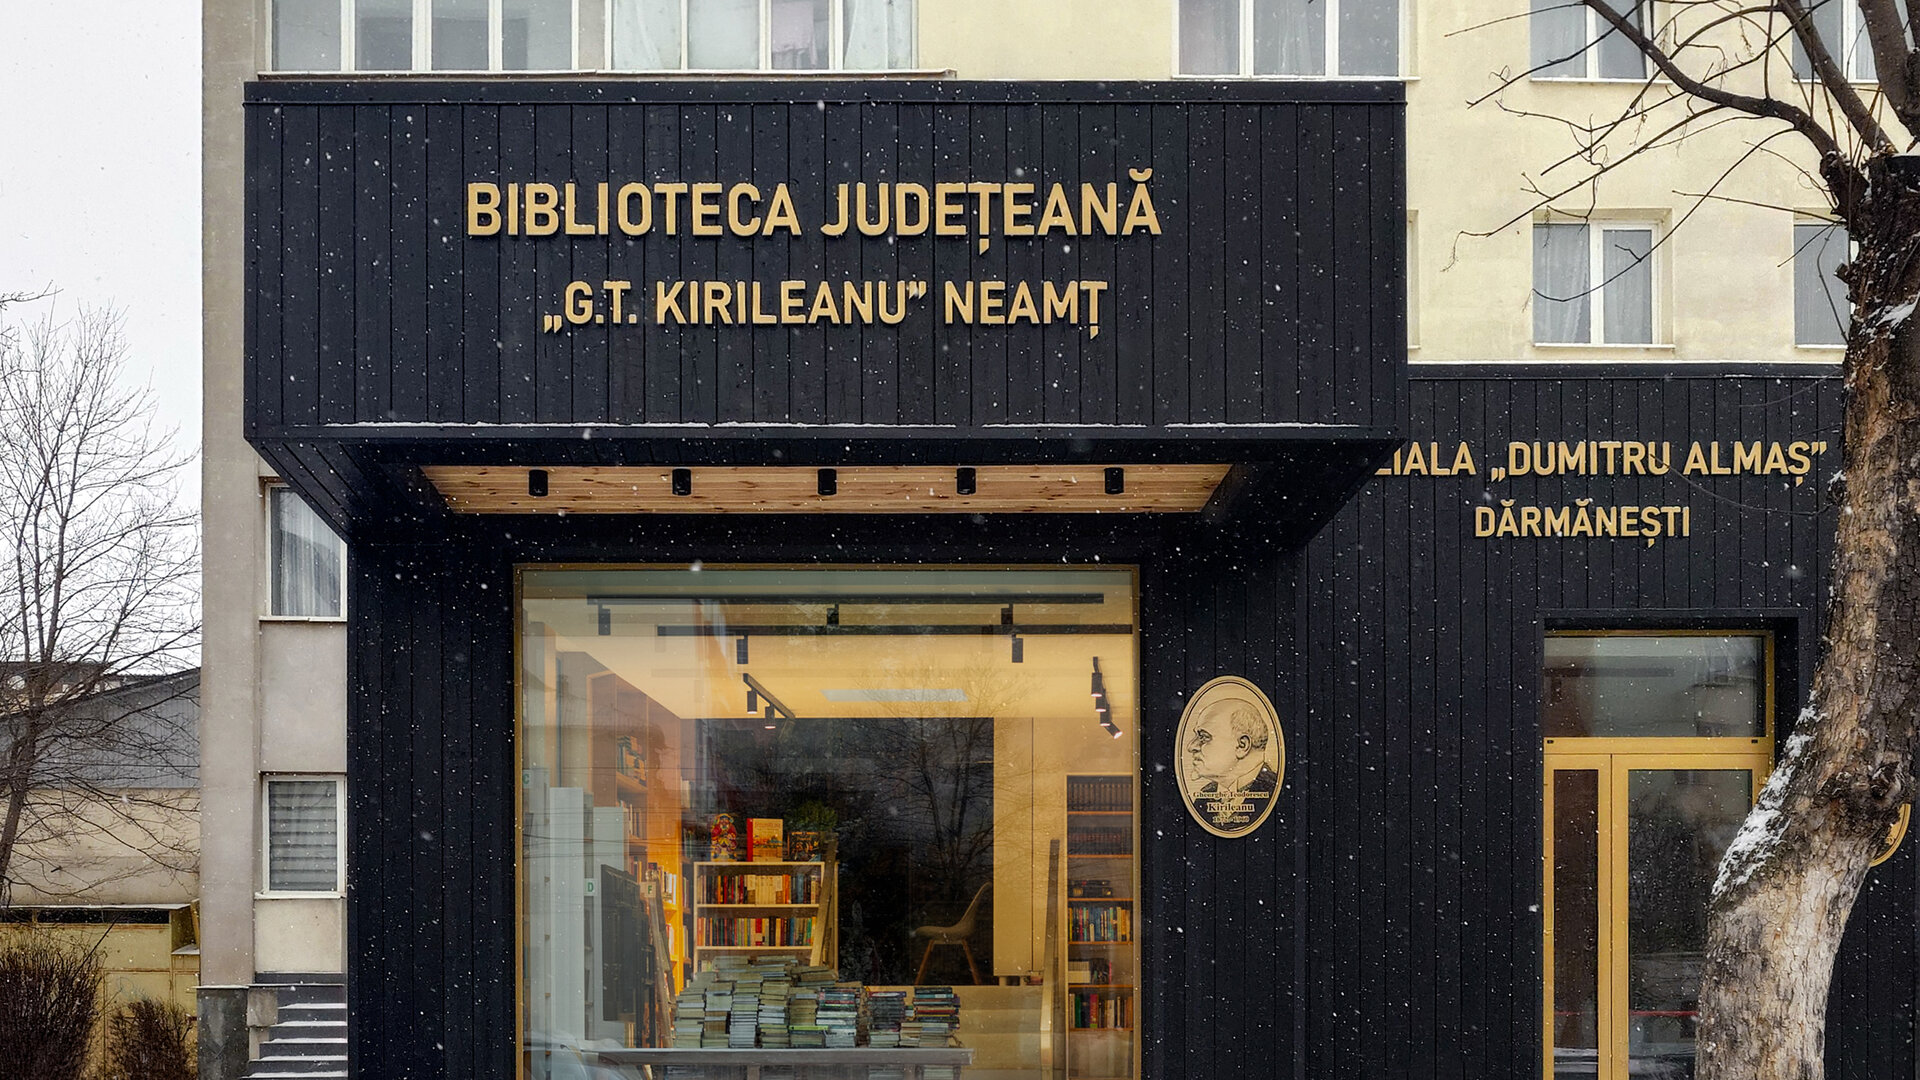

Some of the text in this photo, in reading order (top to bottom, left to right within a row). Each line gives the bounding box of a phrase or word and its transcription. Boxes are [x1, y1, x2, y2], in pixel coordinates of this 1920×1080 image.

[467, 167, 1162, 254] BIBLIOTECA JUDEȚEANĂ
[944, 281, 1109, 339] NEAMȚ
[1490, 441, 1671, 482] „DUMITRU
[1474, 499, 1691, 548] DĂRMĂNEȘTI
[1208, 803, 1254, 811] Kirileanu
[587, 882, 594, 892] D
